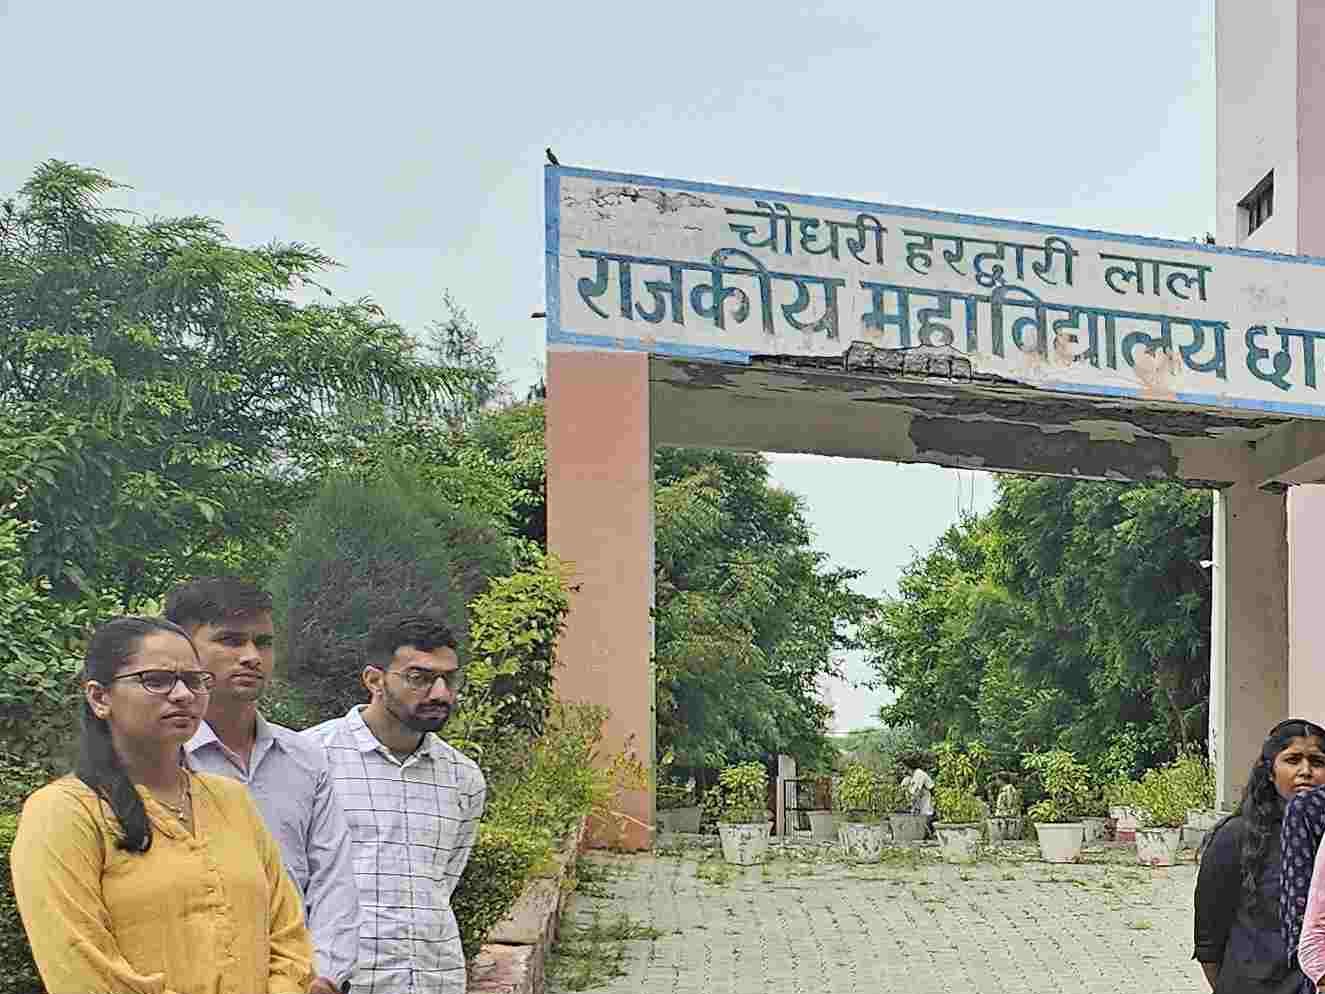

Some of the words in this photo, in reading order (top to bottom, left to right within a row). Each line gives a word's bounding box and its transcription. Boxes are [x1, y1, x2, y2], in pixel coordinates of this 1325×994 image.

[577, 248, 845, 339] राजकीय
[724, 200, 887, 264] चौधरी
[903, 228, 1079, 287] हरद्वारी
[1098, 252, 1215, 301] लाल
